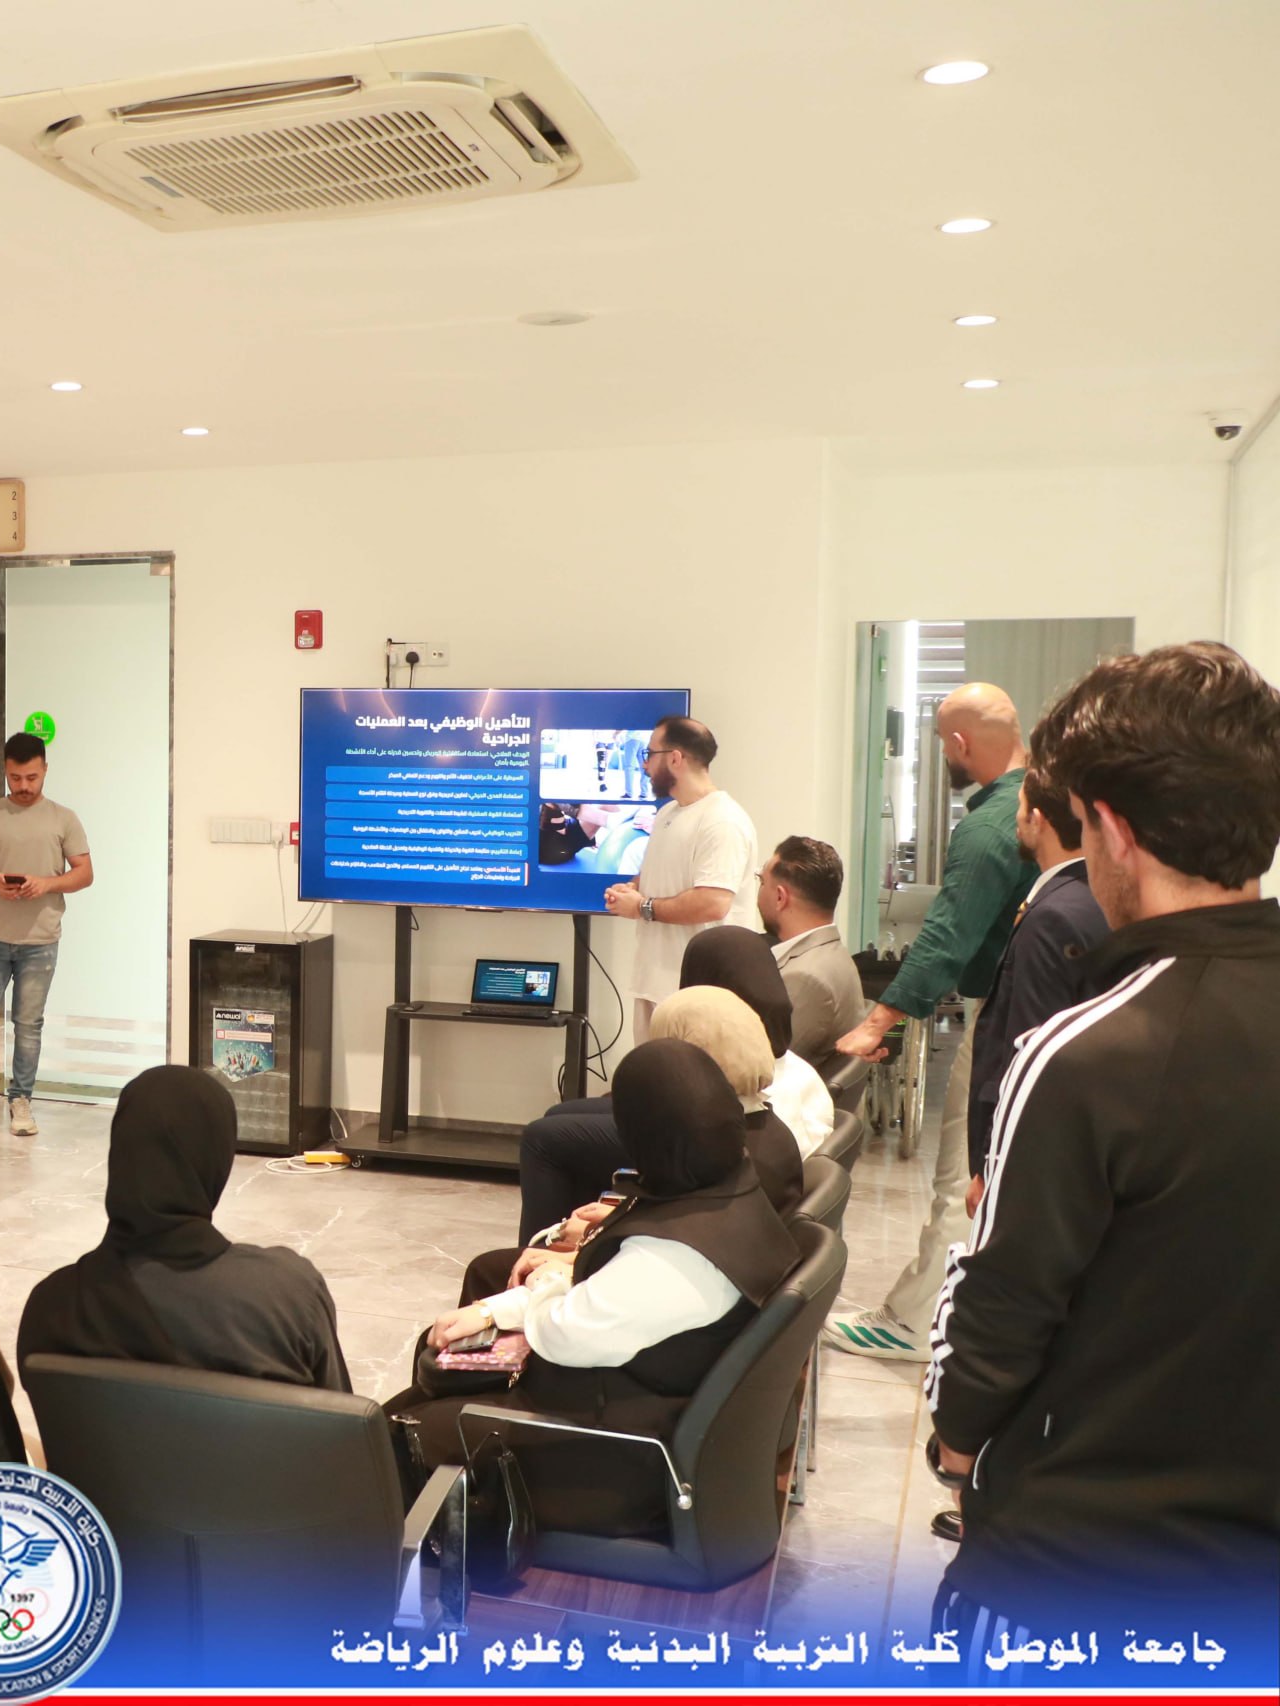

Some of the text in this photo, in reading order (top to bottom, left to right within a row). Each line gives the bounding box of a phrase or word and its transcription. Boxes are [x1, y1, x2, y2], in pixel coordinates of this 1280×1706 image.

[11, 491, 17, 501] 2
[12, 511, 17, 521] 3
[12, 531, 17, 541] 4
[355, 713, 530, 733] التأهيل الوظيفي بعد العمليات
[482, 732, 530, 747] الجراحية
